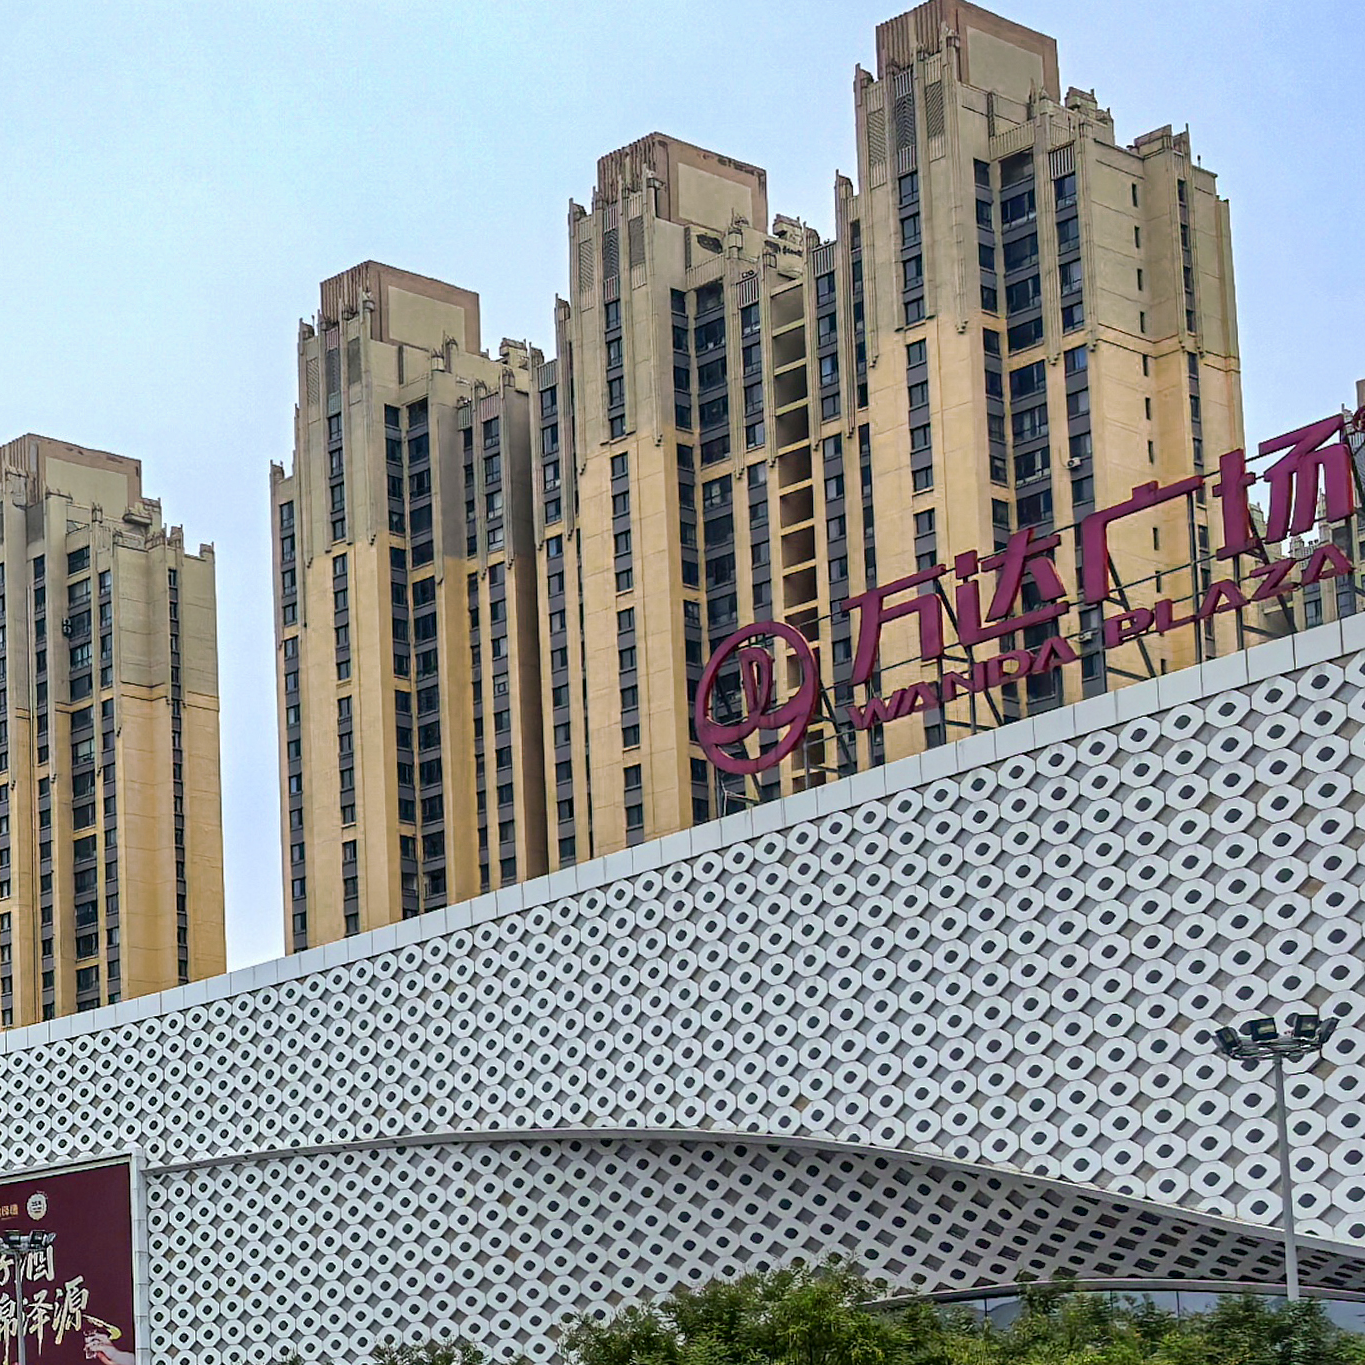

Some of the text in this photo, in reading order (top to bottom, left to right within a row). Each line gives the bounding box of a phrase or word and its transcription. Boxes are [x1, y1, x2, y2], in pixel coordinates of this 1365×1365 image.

[841, 415, 1355, 687] 万达广场
[848, 543, 1356, 731] WANDA PLAZA
